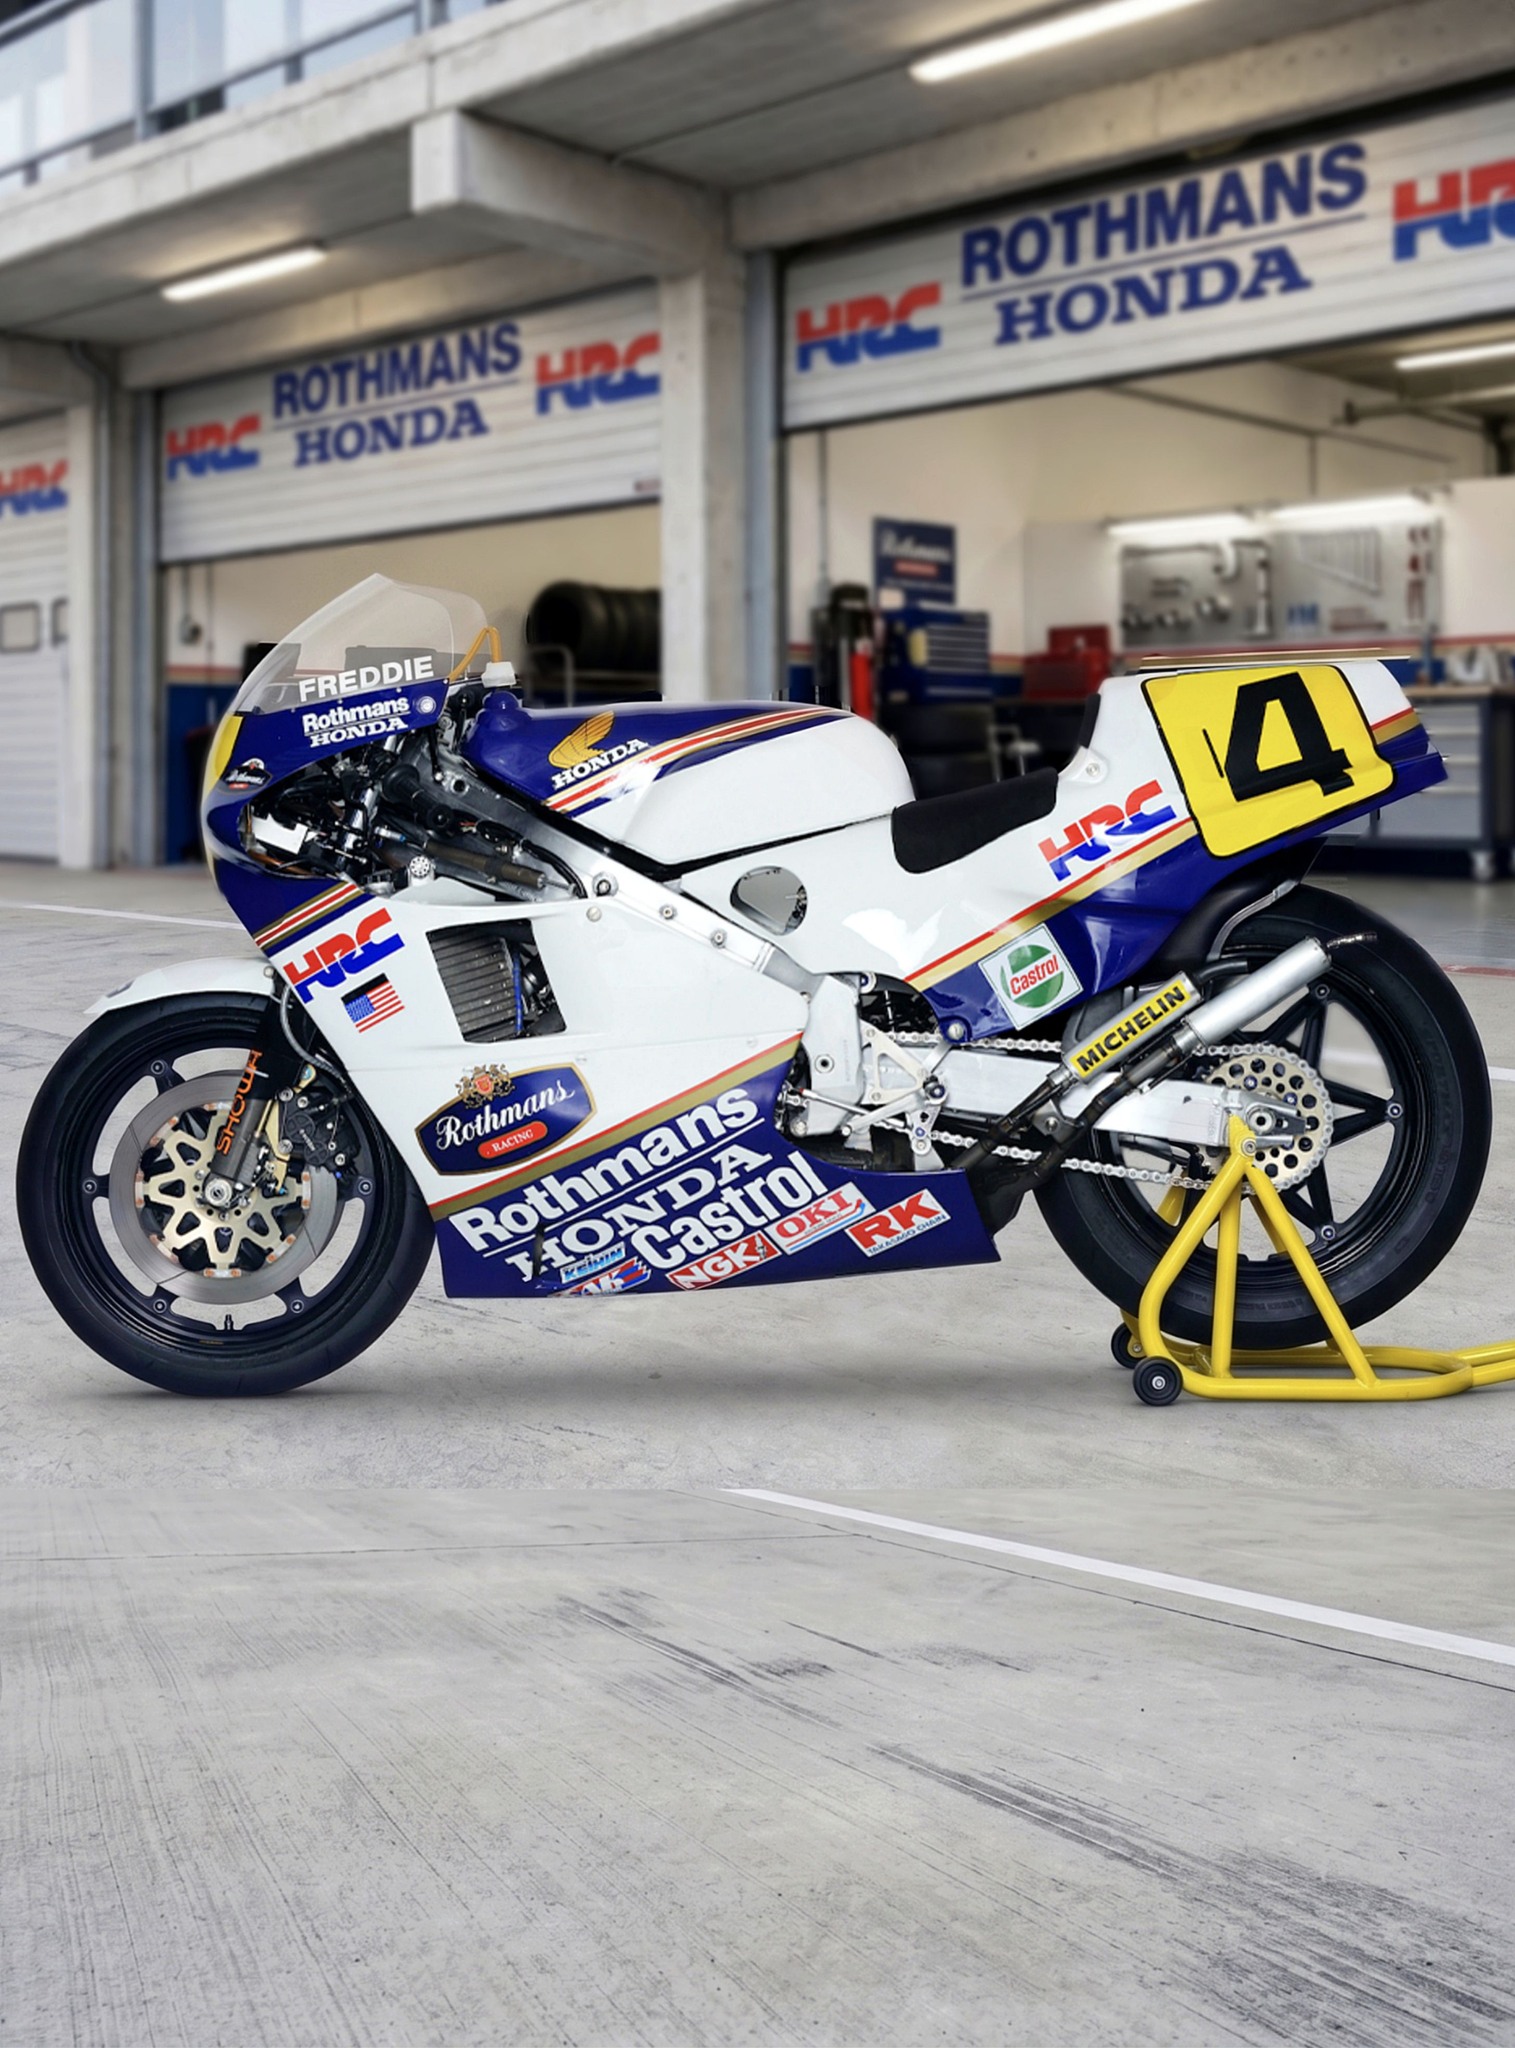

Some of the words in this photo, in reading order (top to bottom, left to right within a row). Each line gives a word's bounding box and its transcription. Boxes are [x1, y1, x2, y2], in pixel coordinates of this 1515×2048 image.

[961, 142, 1367, 288] ROTHMANS
[1393, 158, 1515, 263] HR
[796, 283, 941, 372] HRC
[993, 245, 1313, 346] HONDA
[272, 322, 522, 419] ROTHMANS
[536, 330, 661, 416] HRC
[166, 415, 260, 480] HRC
[293, 399, 488, 467] HONDA
[299, 655, 434, 702] FREDDIE
[302, 697, 410, 734] Rothmans
[310, 717, 408, 748] HONDA
[551, 738, 649, 790] HONDA
[1224, 671, 1355, 798] 4
[1038, 779, 1177, 881] HRC
[284, 907, 405, 1004] HRC
[1010, 955, 1059, 996] Castrol
[1077, 986, 1185, 1072] MICHELIN
[217, 1049, 262, 1155] SHOWA
[436, 1080, 576, 1150] Rothmans
[492, 1129, 533, 1152] RACING
[448, 1088, 759, 1252] Rothmans
[505, 1143, 772, 1282] HONDA
[631, 1150, 830, 1270] Castrol
[775, 1191, 853, 1238] OKI
[849, 1192, 941, 1249] RK
[673, 1243, 761, 1288] NGK
